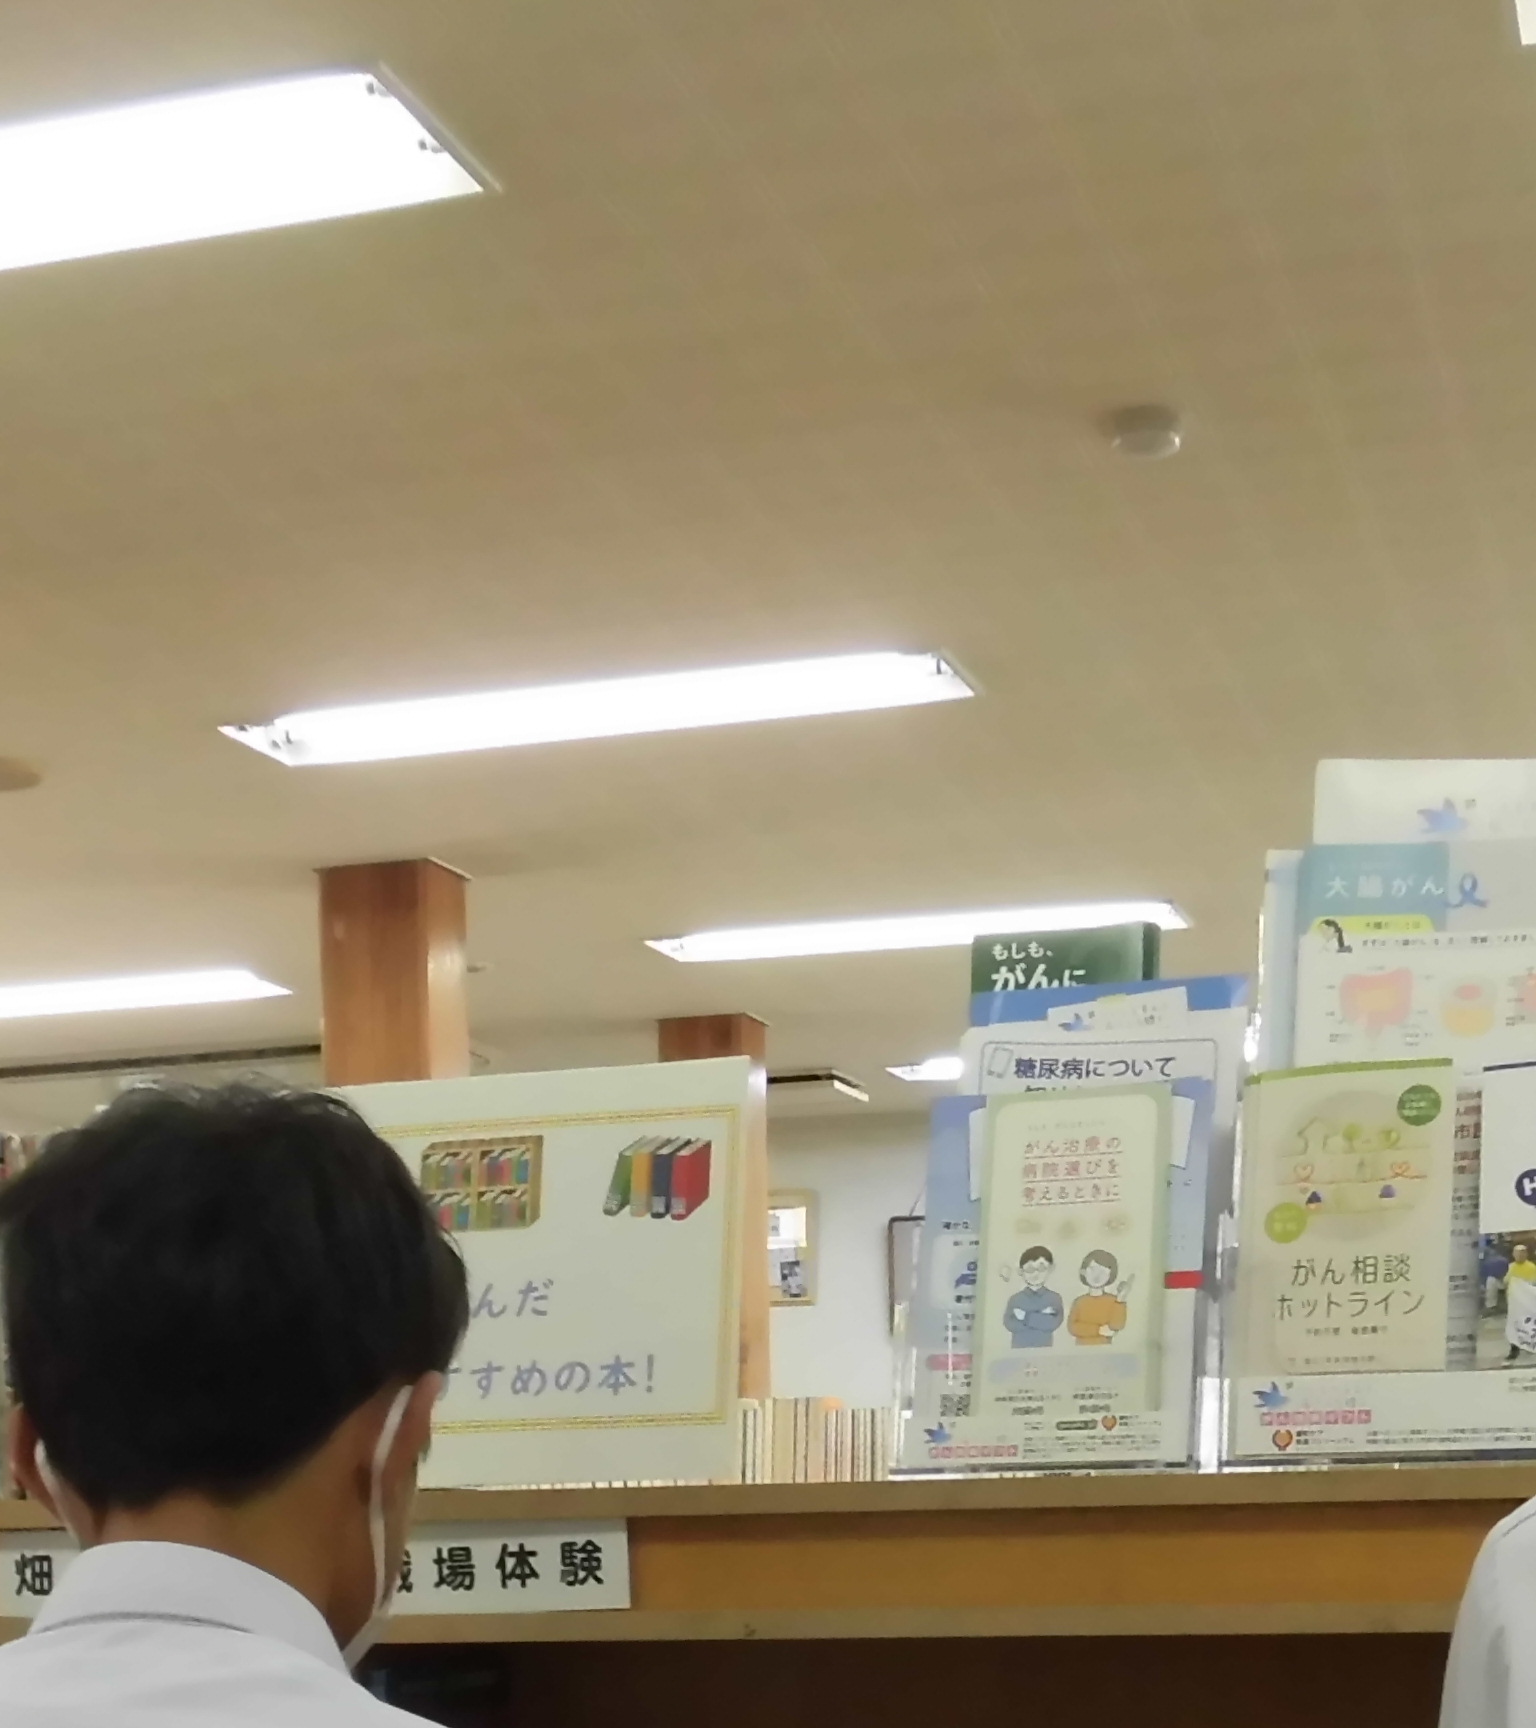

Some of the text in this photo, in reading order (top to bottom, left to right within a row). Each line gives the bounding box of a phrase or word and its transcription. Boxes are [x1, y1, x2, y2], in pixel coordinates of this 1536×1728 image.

[1014, 1056, 1177, 1081] 糖尿病について
[1291, 1254, 1412, 1287] がん相談
[1272, 1289, 1426, 1321] ホットライン
[448, 1353, 655, 1400] すめの本!
[15, 1553, 54, 1597] 畑
